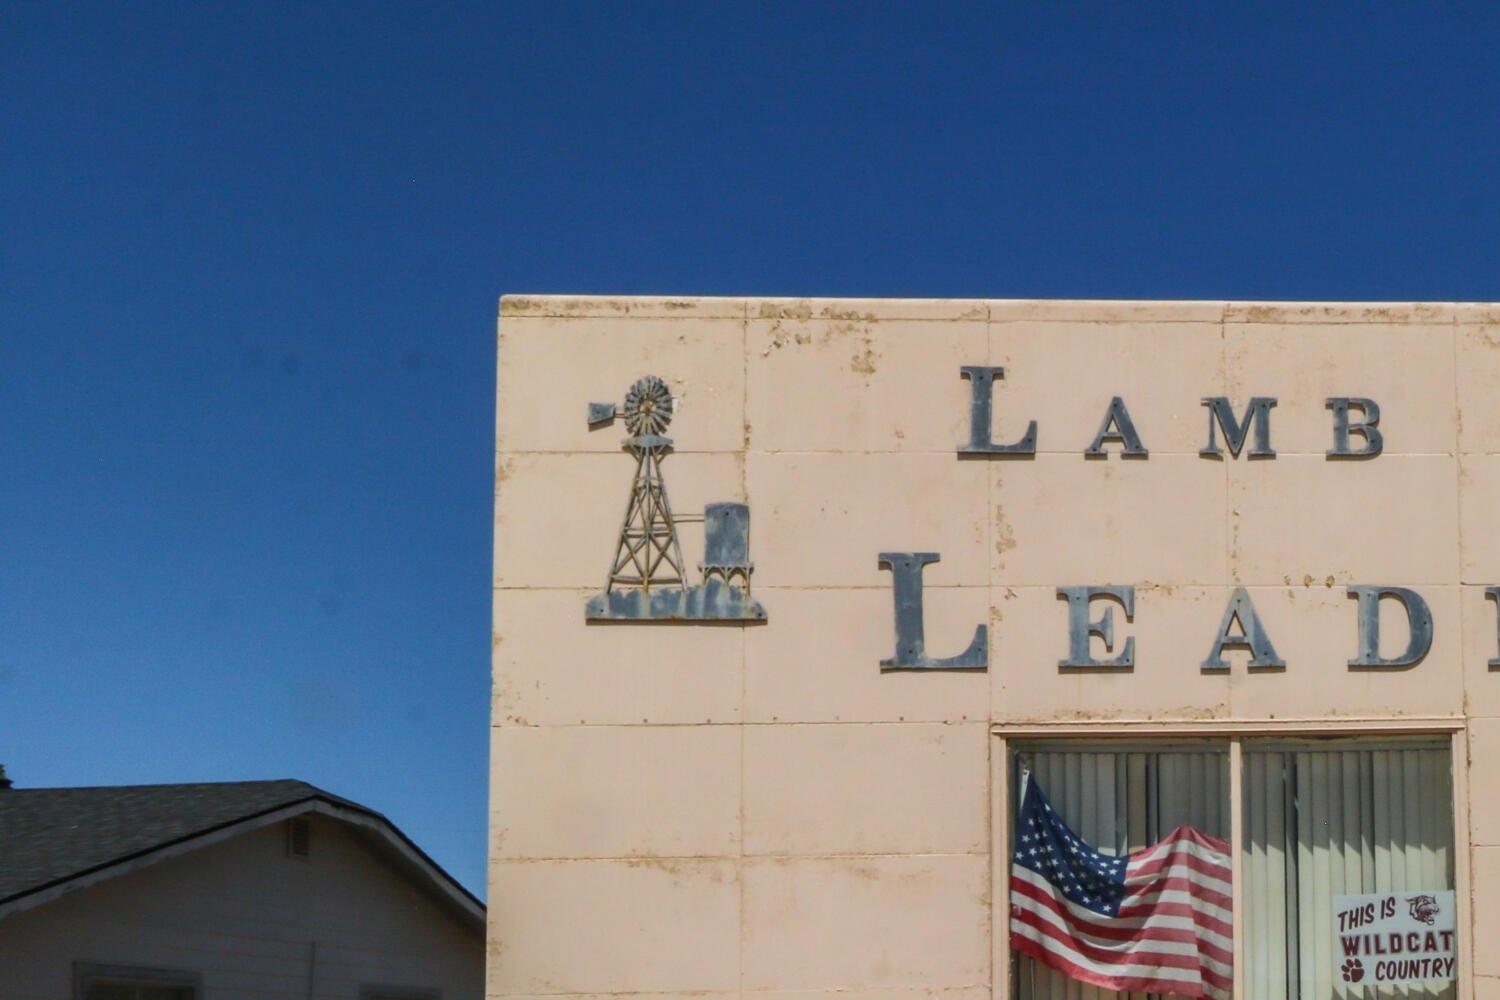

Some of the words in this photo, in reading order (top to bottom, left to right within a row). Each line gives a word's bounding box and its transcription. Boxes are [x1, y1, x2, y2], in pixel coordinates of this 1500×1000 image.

[957, 365, 1384, 461] LAMB
[1337, 902, 1375, 933] THIS
[1380, 896, 1396, 920] IS
[1339, 929, 1455, 957] WILDCAT
[1374, 957, 1455, 981] COUNTRY
